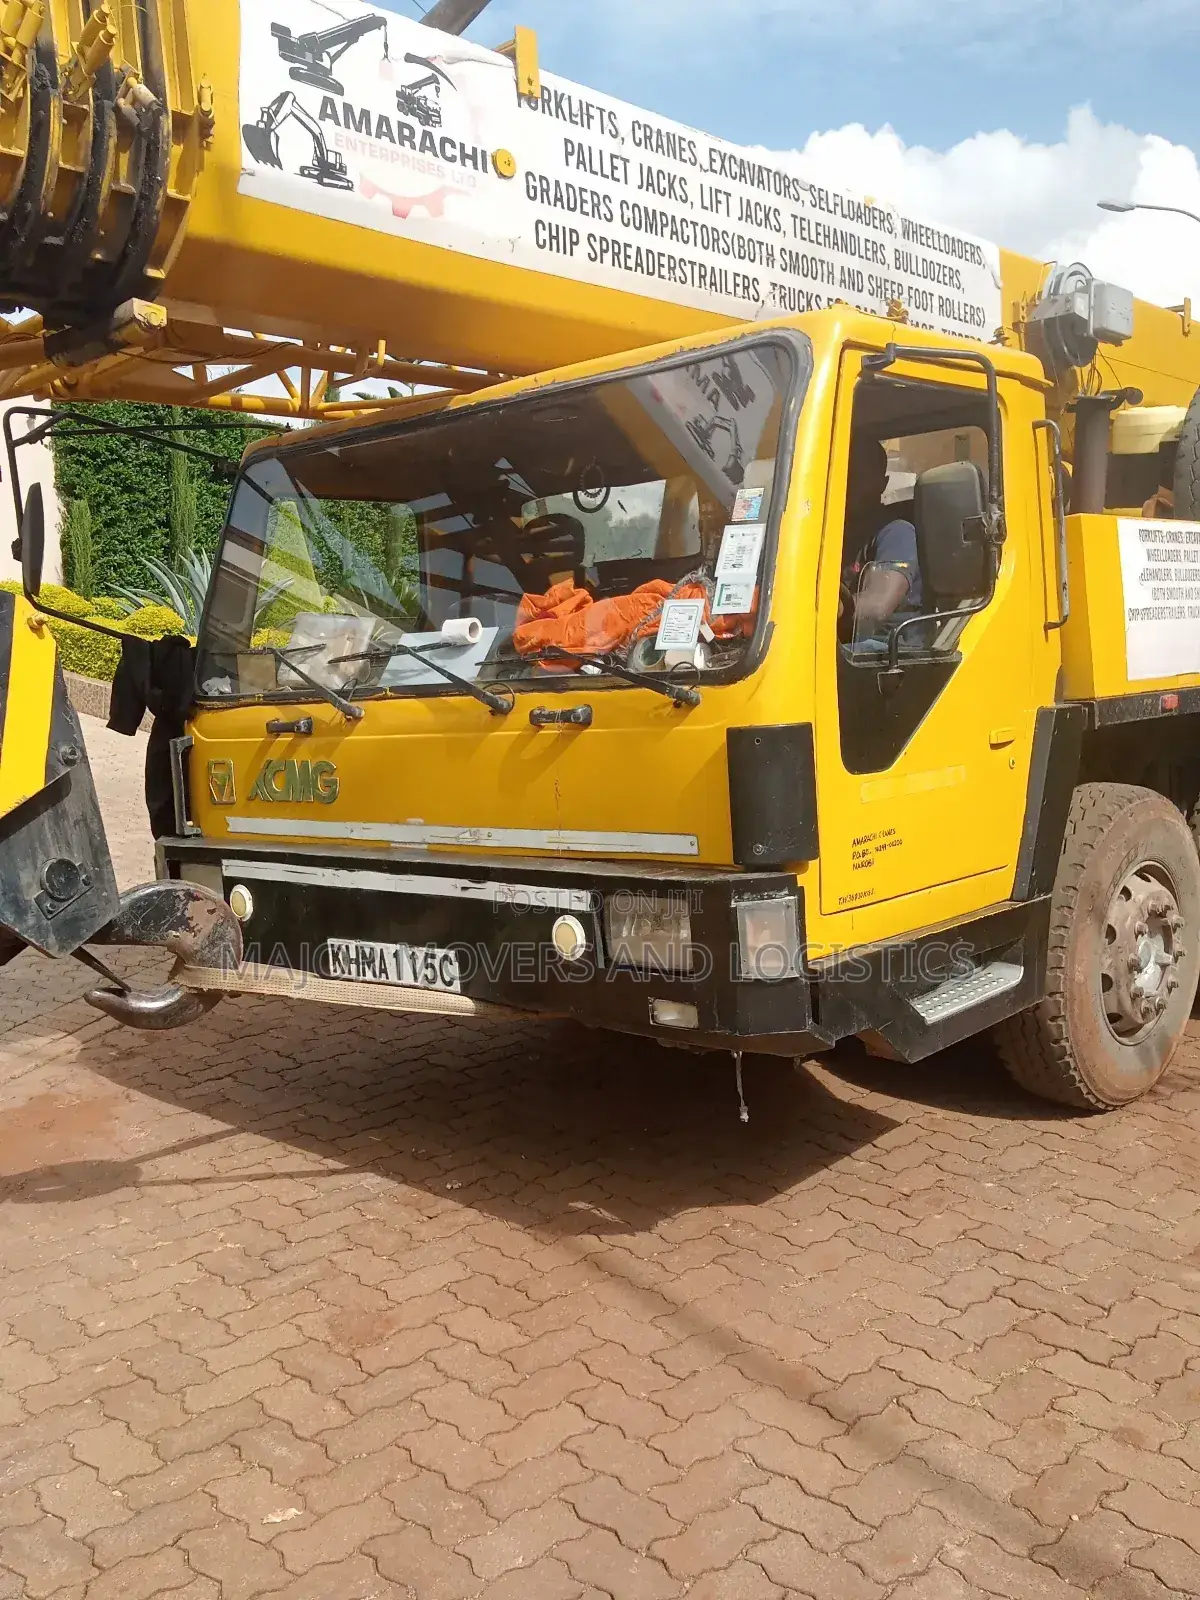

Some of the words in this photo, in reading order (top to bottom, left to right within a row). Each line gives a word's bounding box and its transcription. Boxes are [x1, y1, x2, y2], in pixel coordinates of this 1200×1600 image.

[318, 95, 489, 174] AMARACHI
[333, 131, 447, 180] ENTERPRISES
[451, 168, 478, 188] LTD
[534, 219, 580, 258] CHIP
[563, 137, 630, 186] PALLET
[637, 162, 695, 209] JACKS,
[699, 182, 731, 218] LIFT
[738, 196, 787, 239] JACKS,
[790, 213, 891, 270] TELEHANDLERS,
[894, 249, 966, 293] BULLDOZERS,
[708, 147, 805, 208] EXCAVATORS,
[809, 183, 898, 239] SELFLOADERS,
[901, 217, 986, 269] WHEELLOADERS,
[524, 171, 614, 223] GRADERS
[780, 247, 835, 286] SMOOTH
[839, 266, 864, 294] AND
[908, 286, 935, 314] FOOT
[938, 297, 987, 329] ROLLERS)
[248, 758, 340, 804] XCMG
[328, 942, 390, 981] KHMA
[392, 948, 458, 988] 115C
